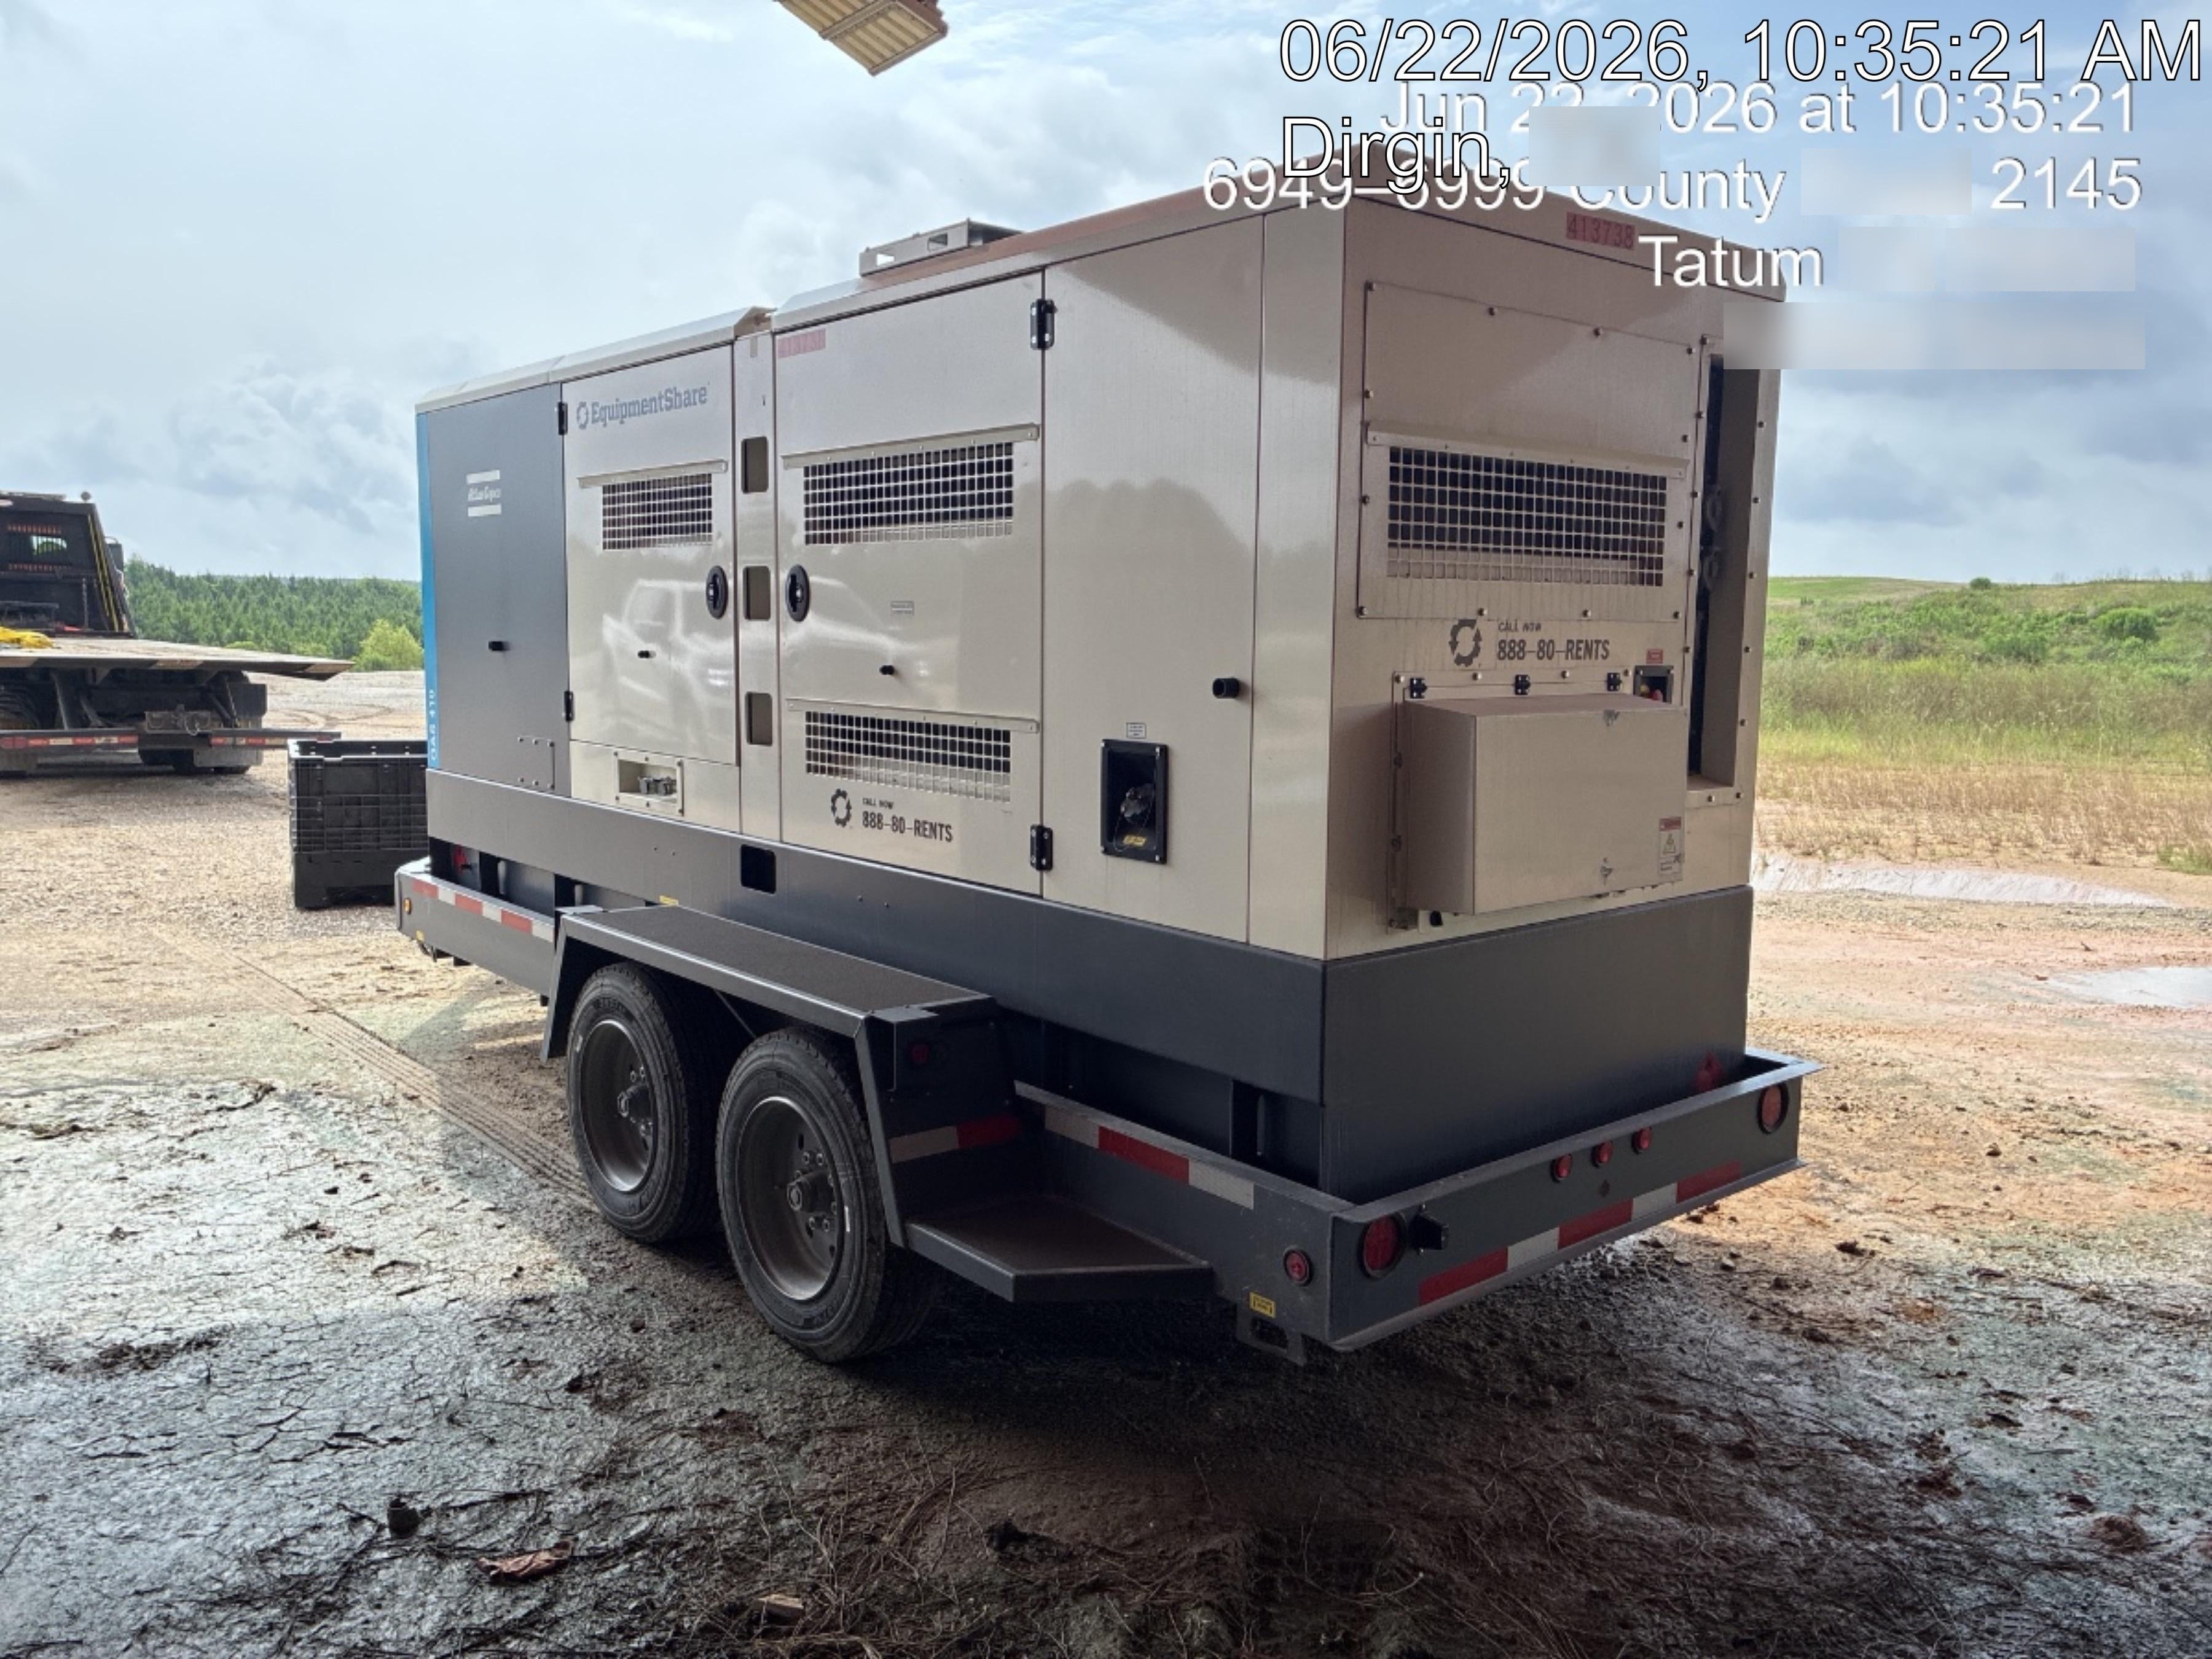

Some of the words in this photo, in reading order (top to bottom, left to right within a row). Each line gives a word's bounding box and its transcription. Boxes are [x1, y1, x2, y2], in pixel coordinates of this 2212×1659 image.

[1567, 213, 1634, 249] 413738
[590, 386, 708, 428] EquipmentShare
[1497, 639, 1610, 661] 888-80-RENTS
[862, 810, 954, 843] 888-80-RENTS
